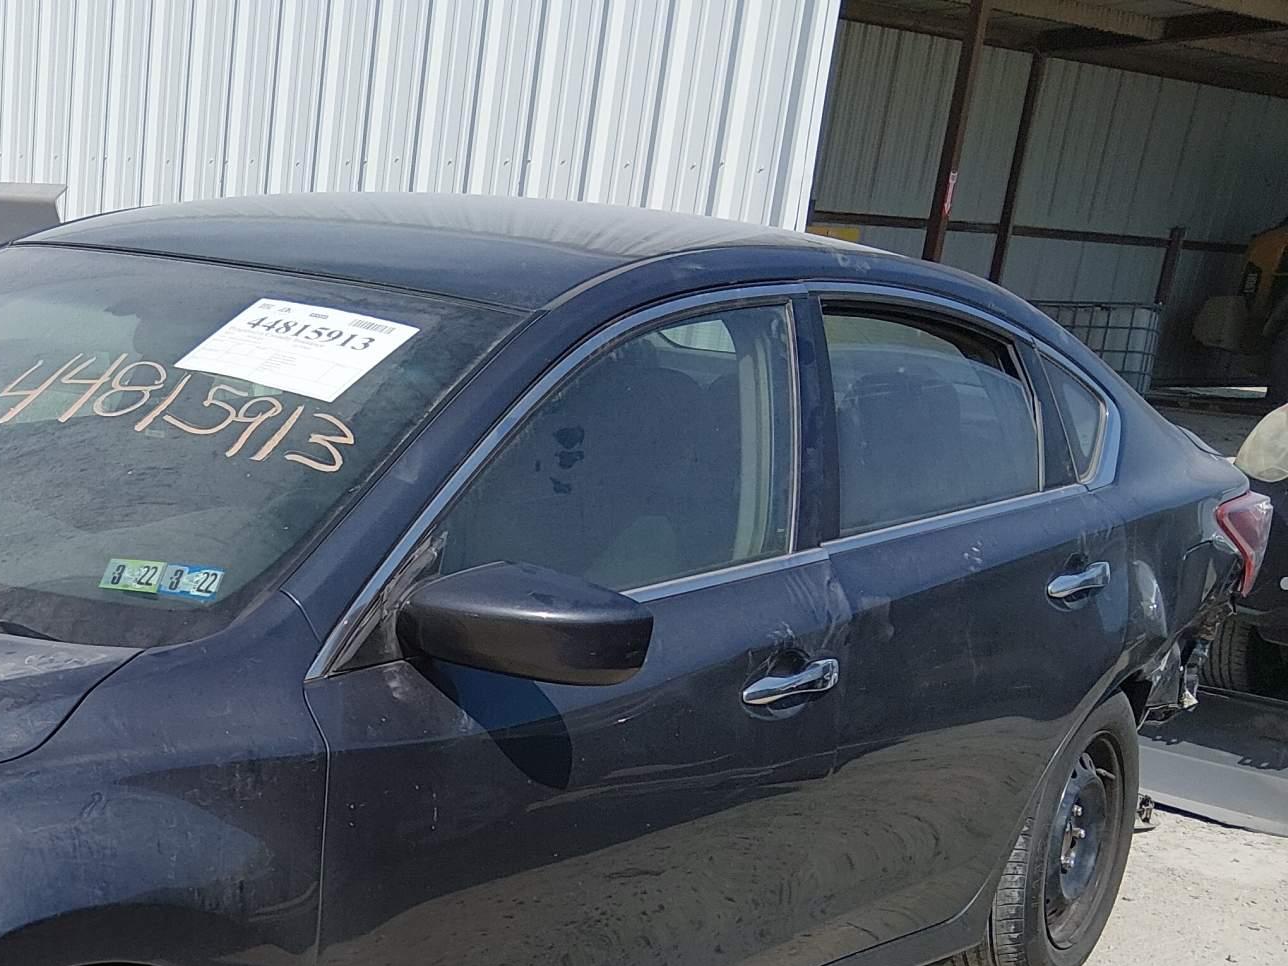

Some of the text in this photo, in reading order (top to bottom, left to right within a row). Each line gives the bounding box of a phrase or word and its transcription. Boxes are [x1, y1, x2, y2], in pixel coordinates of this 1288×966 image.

[247, 315, 376, 351] 44815913
[136, 565, 159, 587] 22
[195, 571, 219, 594] 22
